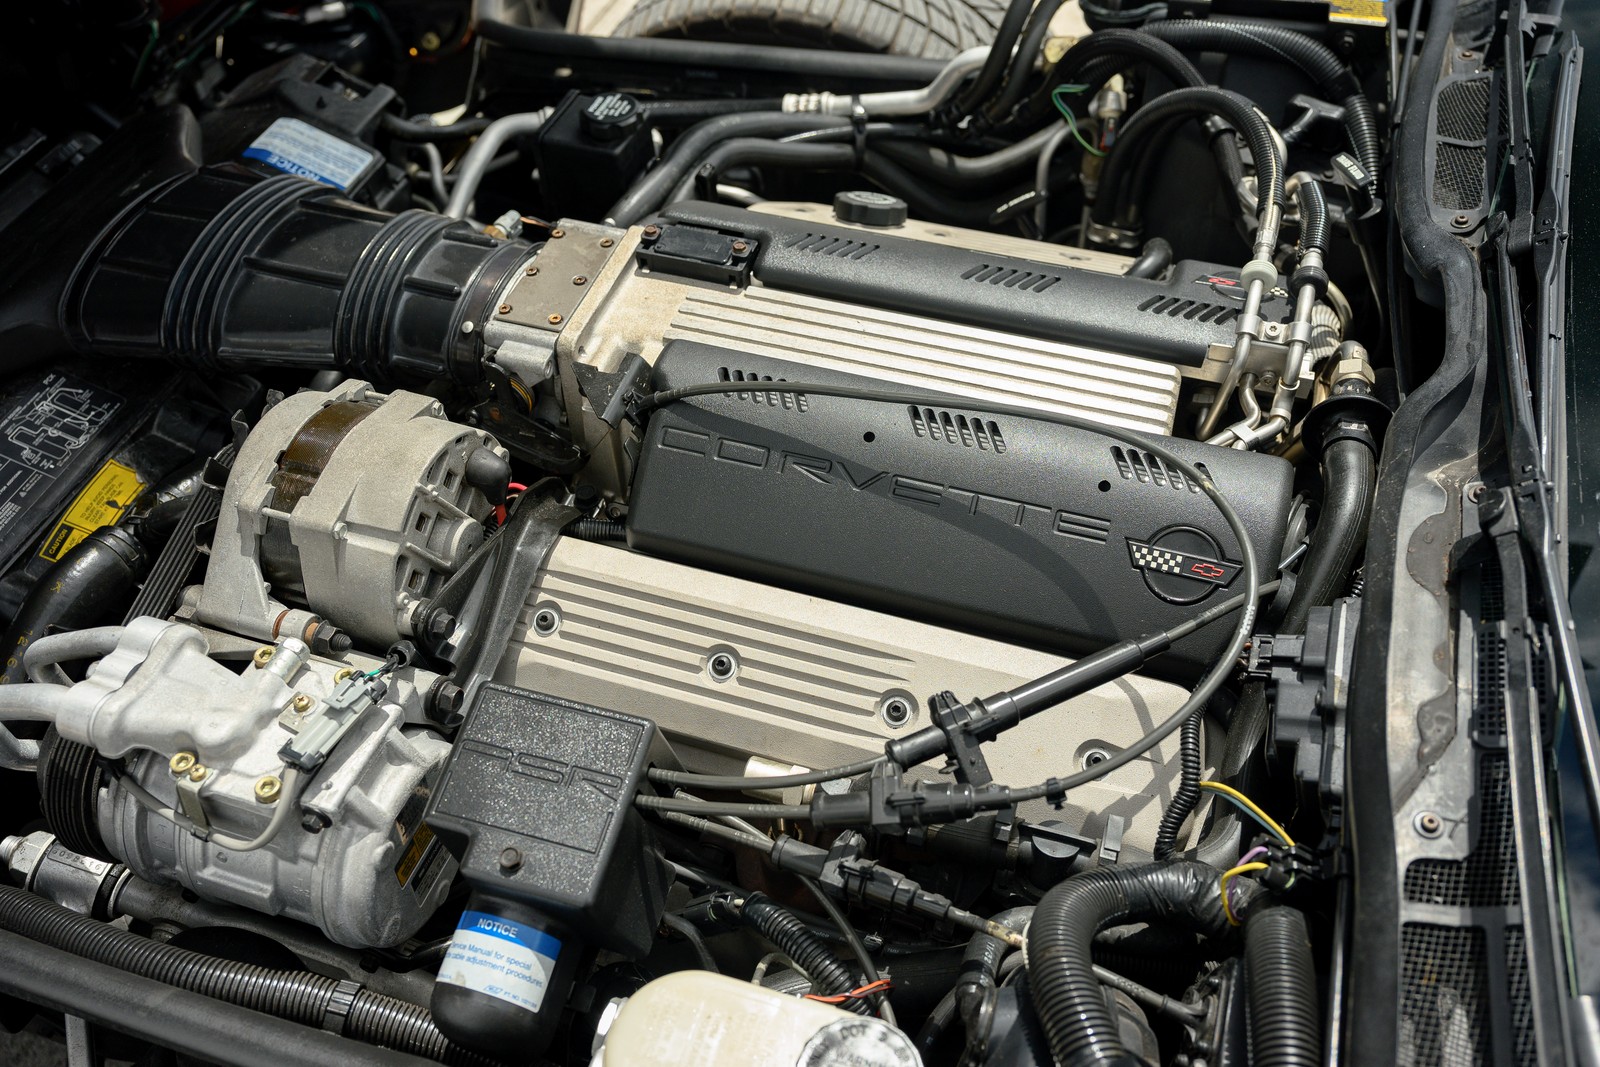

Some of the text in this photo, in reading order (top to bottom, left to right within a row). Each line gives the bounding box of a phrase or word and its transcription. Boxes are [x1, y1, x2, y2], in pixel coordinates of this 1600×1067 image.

[267, 153, 320, 181] NOTICE
[657, 425, 1112, 545] CORVETTE
[48, 527, 68, 555] CAUTION
[454, 739, 623, 802] ASR
[477, 918, 518, 938] NOTICE
[465, 955, 505, 973] adjustment
[468, 943, 493, 957] Manual
[494, 951, 505, 960] for
[506, 955, 532, 971] special
[982, 941, 995, 964] 11/32
[840, 1024, 867, 1040] DOT
